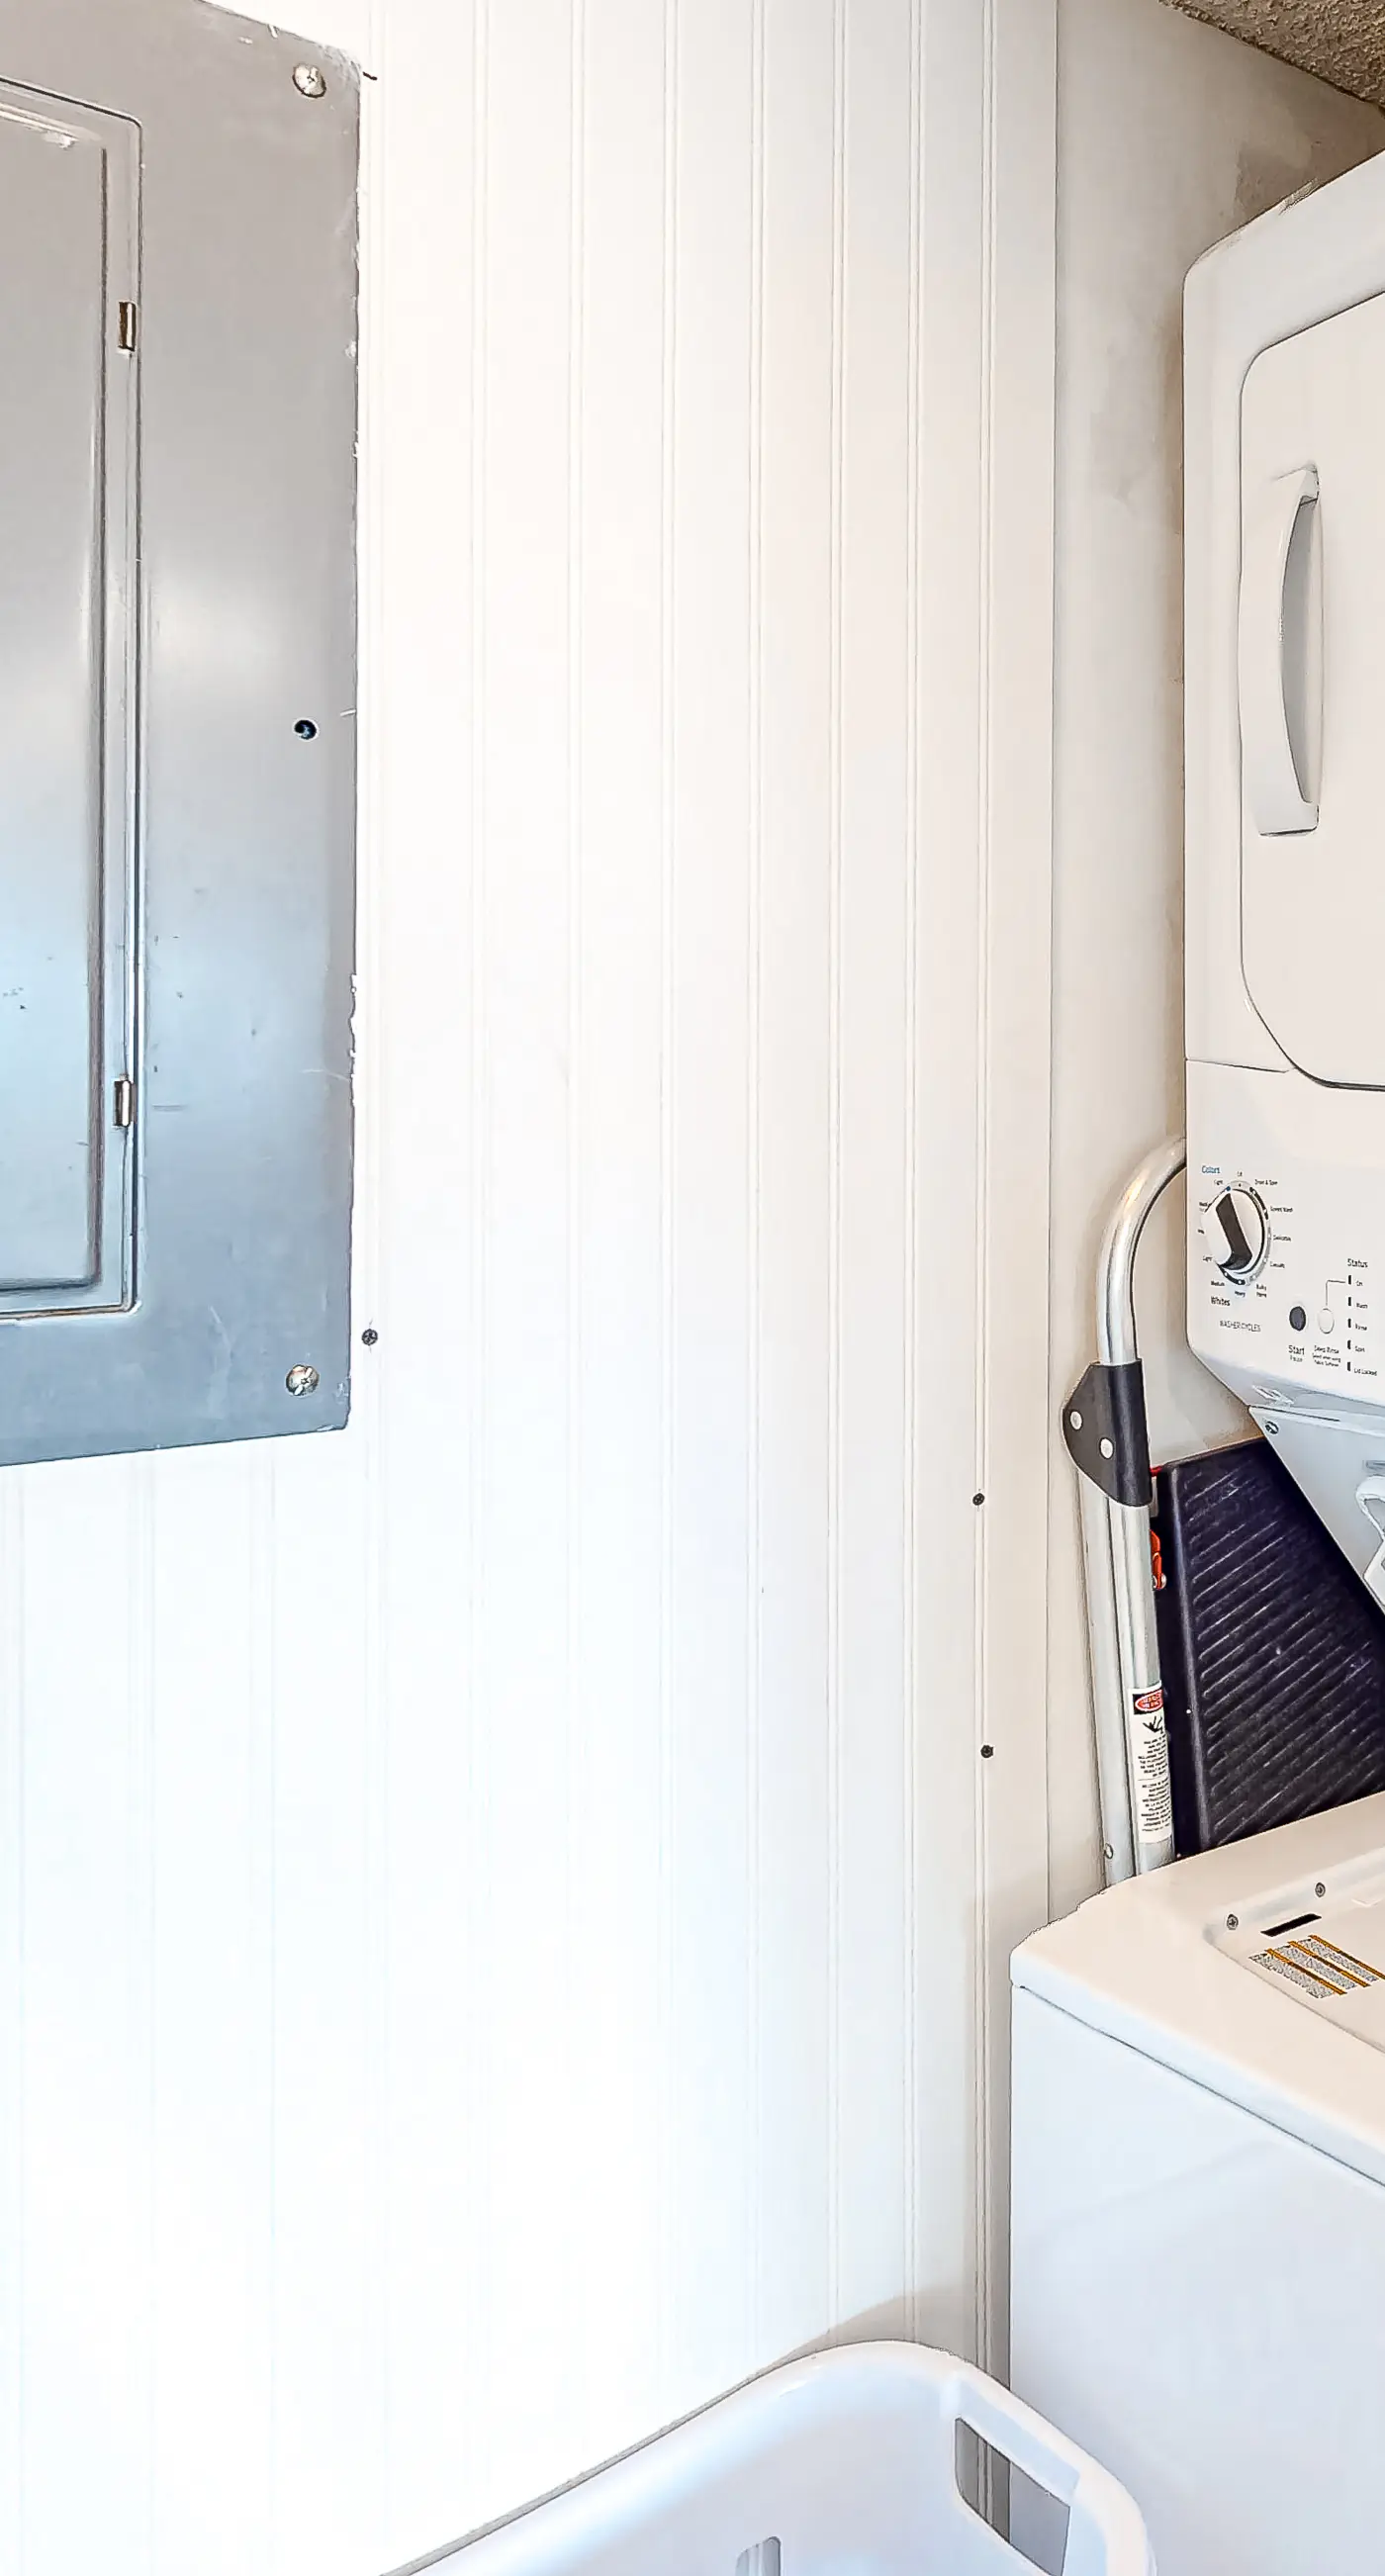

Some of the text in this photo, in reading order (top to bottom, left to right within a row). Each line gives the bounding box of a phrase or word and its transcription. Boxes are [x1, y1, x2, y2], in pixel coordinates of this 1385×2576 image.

[1347, 1257, 1368, 1268] Status
[1210, 1296, 1231, 1307] Whites
[1288, 1344, 1305, 1355] Start
